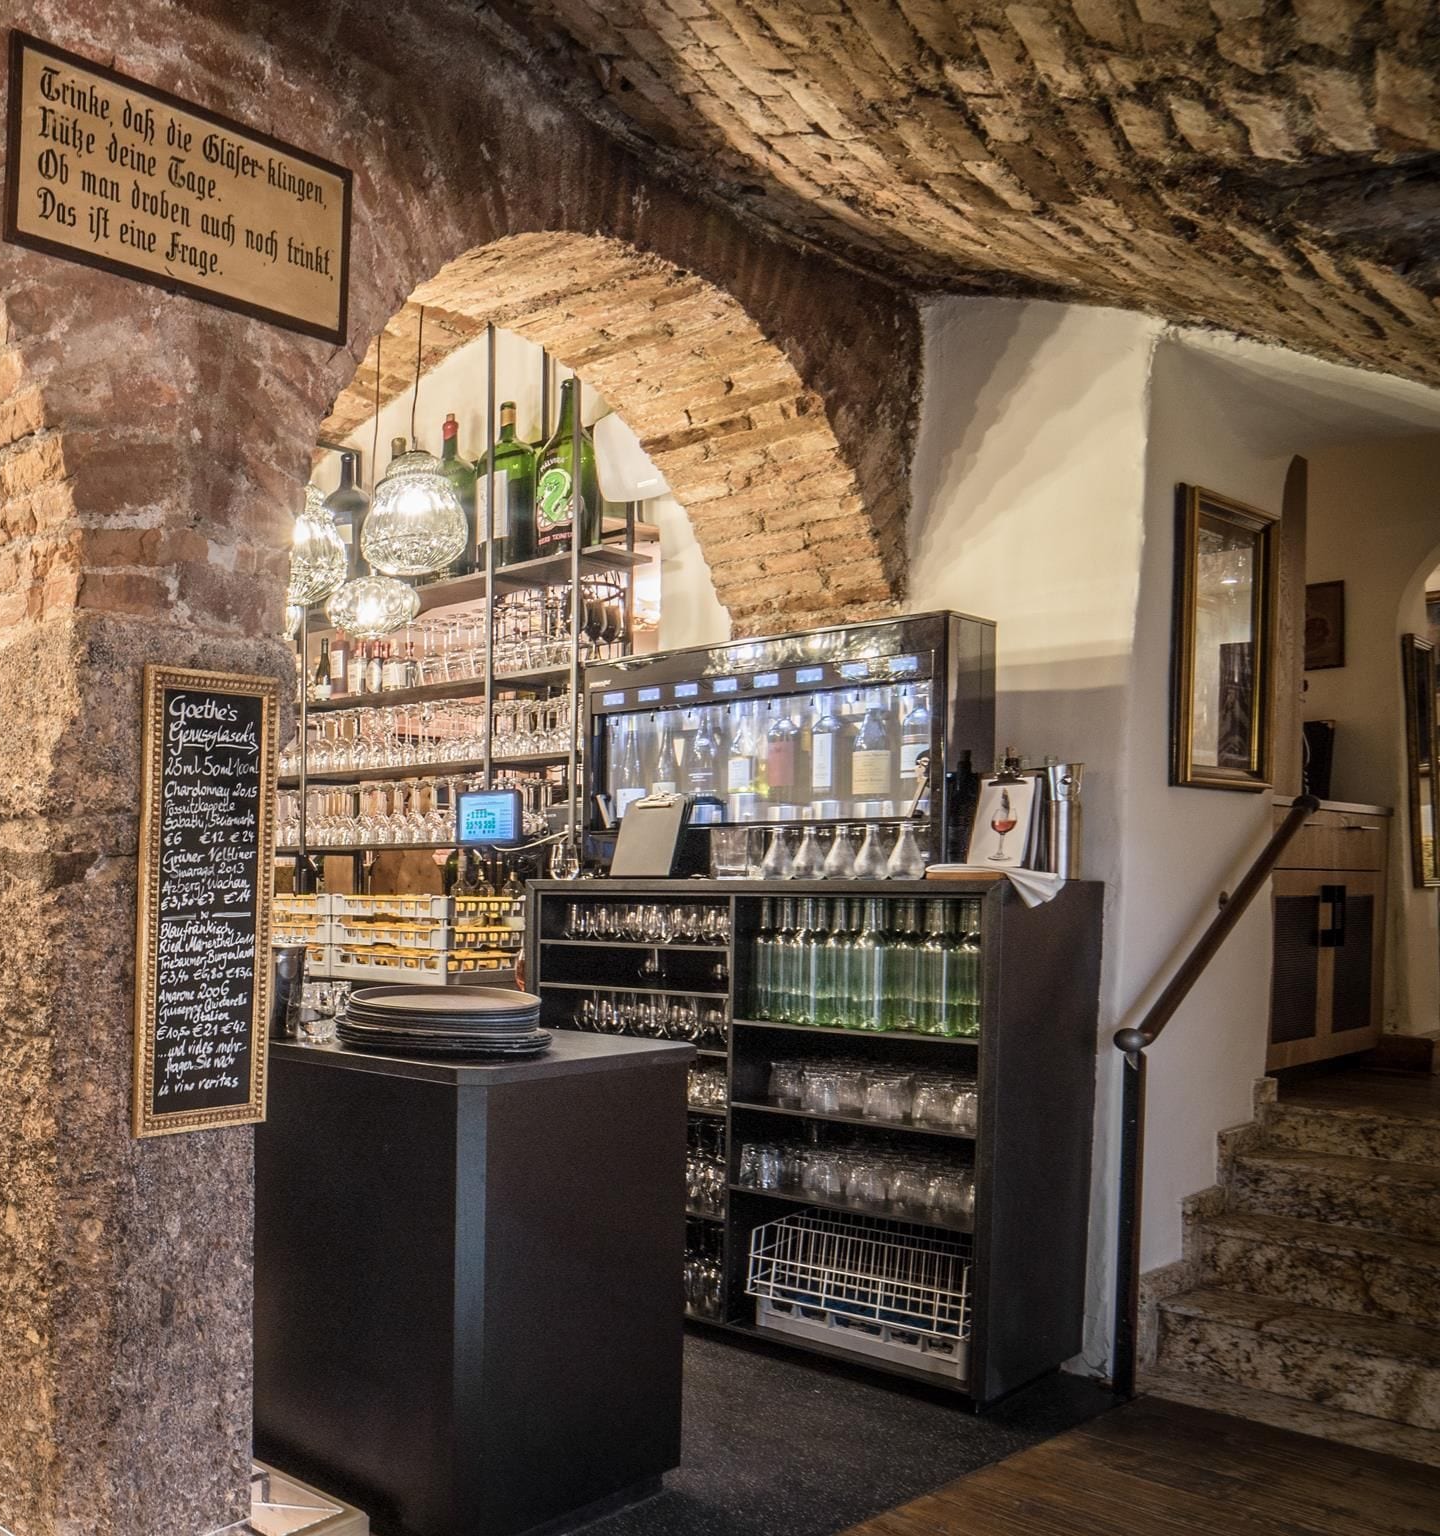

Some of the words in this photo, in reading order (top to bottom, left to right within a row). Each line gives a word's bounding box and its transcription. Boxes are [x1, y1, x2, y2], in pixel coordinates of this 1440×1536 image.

[40, 66, 113, 128] Trinke,
[122, 98, 155, 146] daß
[167, 117, 192, 153] die
[267, 157, 327, 210] klingen,
[108, 132, 156, 177] deine
[167, 155, 222, 202] Tage.
[38, 148, 69, 185] Ob
[81, 170, 122, 203] man
[131, 179, 191, 228] droben
[201, 213, 236, 248] auch
[245, 229, 278, 263] noch
[287, 236, 334, 281] trinkt,
[36, 186, 77, 228] Das
[120, 219, 157, 253] eine
[165, 231, 224, 276] Frage.
[168, 694, 239, 724] Goethe's
[164, 754, 202, 777] 25ml
[202, 755, 234, 777] 50ml
[164, 779, 230, 803] Chardonnay
[232, 782, 258, 798] 2015
[163, 831, 183, 847] €6
[199, 831, 225, 844] €12
[162, 848, 205, 873] Grüner
[207, 846, 257, 862] Veltliner
[217, 862, 245, 874] 2013
[223, 888, 251, 904] €14
[159, 935, 184, 954] Ried
[197, 979, 230, 999] 2006
[192, 1023, 218, 1038] €21
[220, 1020, 247, 1035] €42
[194, 1053, 212, 1069] Sie
[174, 1079, 195, 1094] vino
[198, 1071, 239, 1090] veritas
